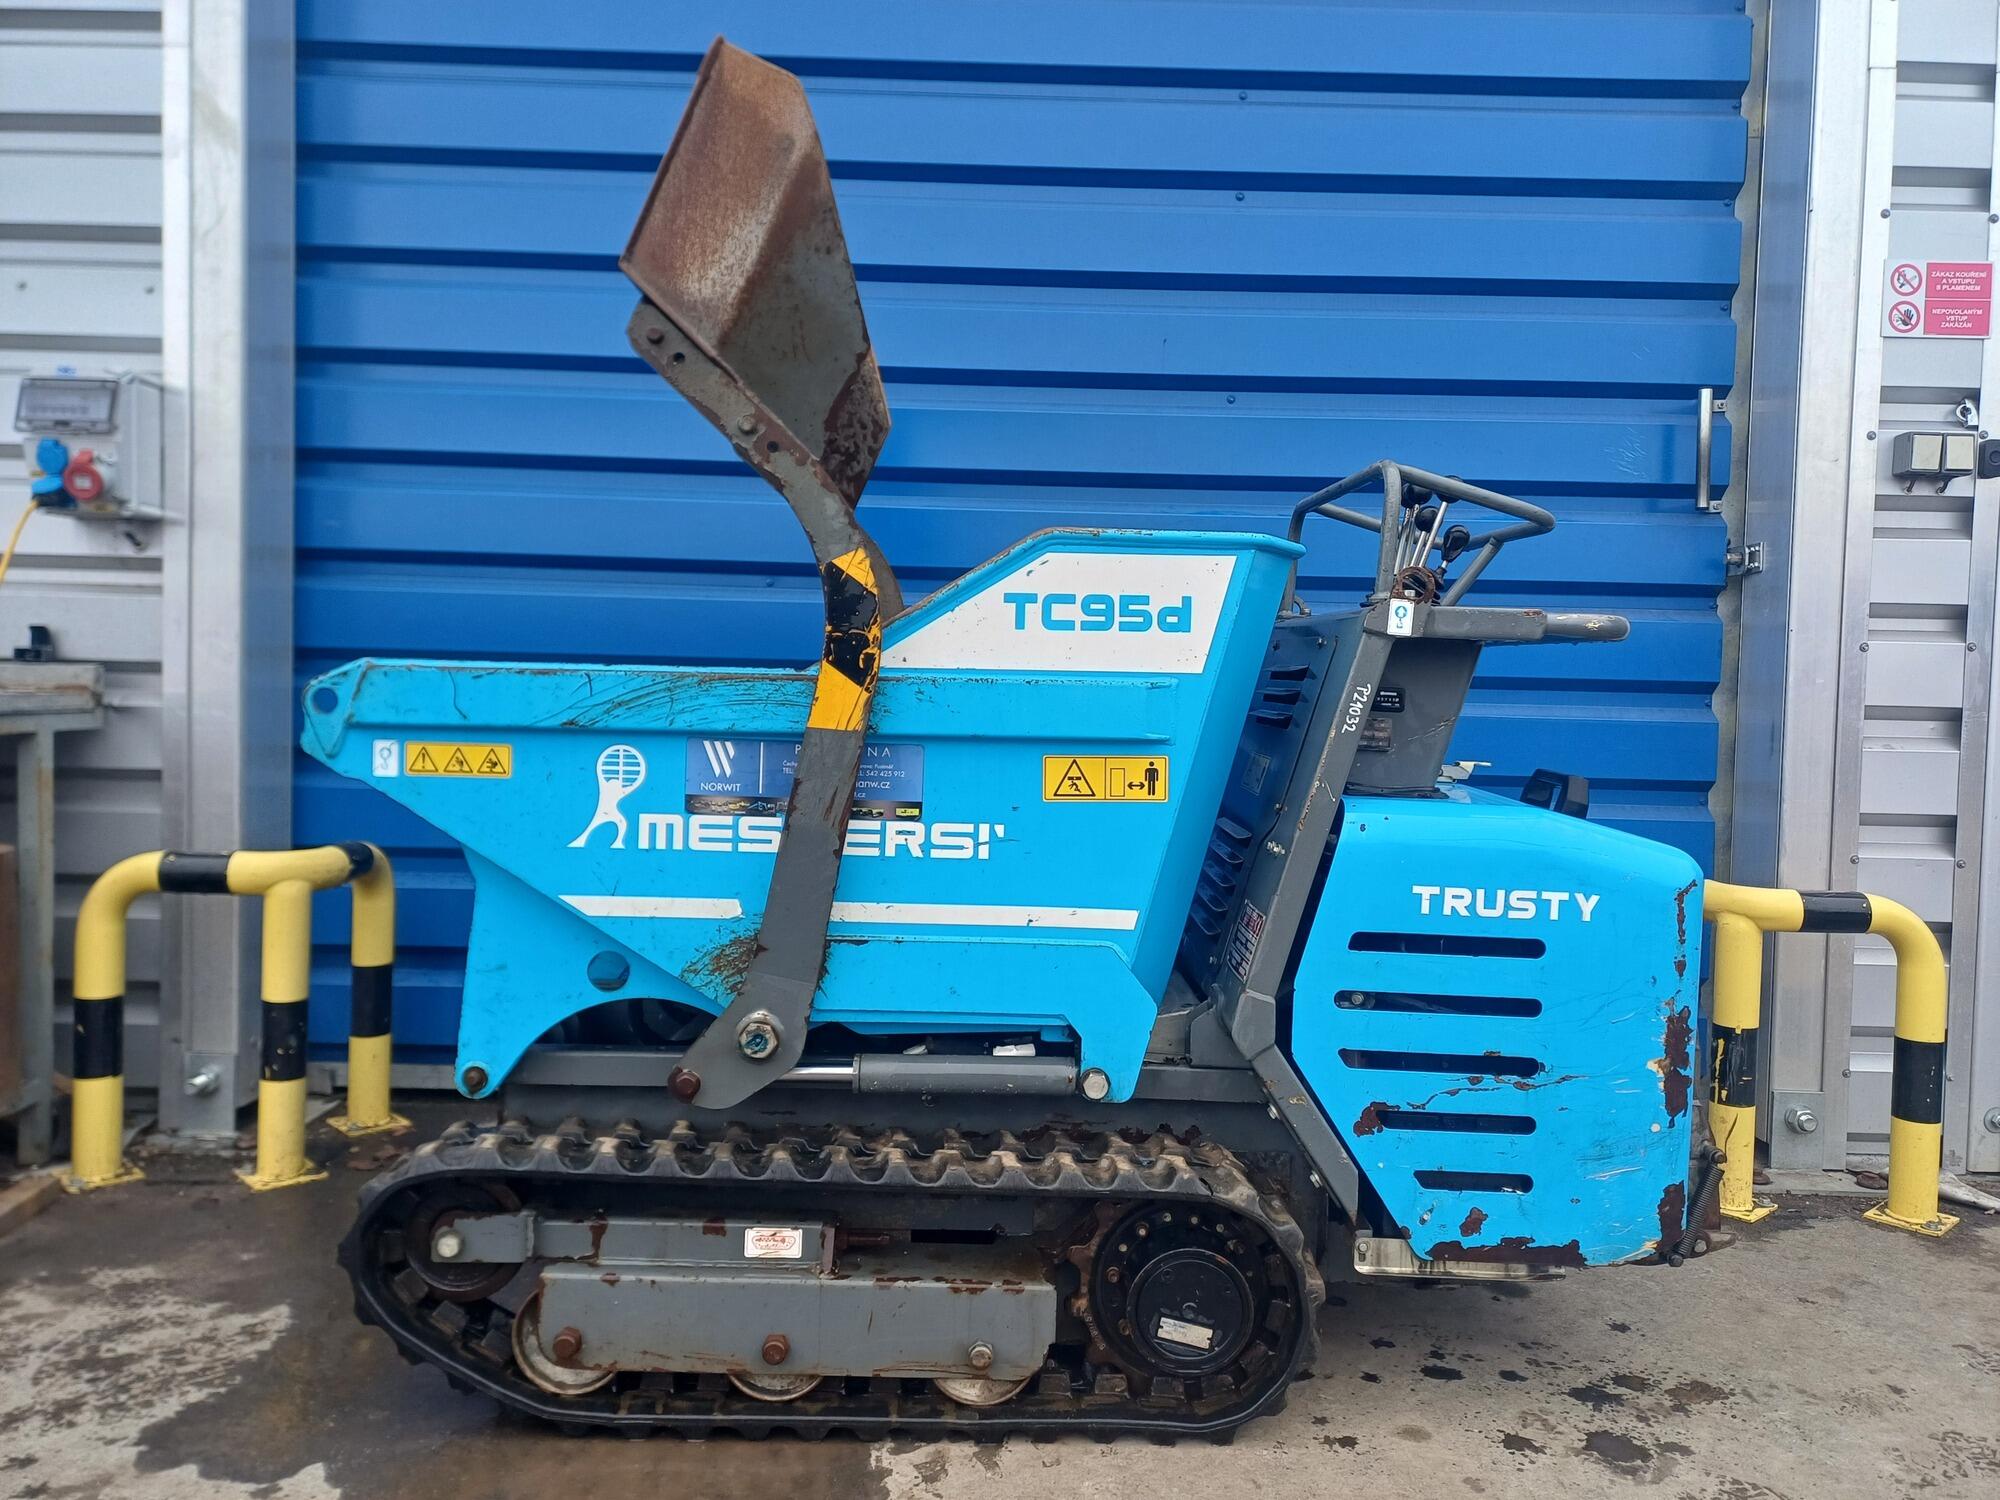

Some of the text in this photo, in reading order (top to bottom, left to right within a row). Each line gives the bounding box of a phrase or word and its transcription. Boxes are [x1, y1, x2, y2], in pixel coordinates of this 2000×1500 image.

[1003, 592, 1192, 633] TC95d
[893, 770, 905, 778] 912
[700, 782, 741, 792] NORWIT
[1411, 885, 1601, 922] TRUSTY
